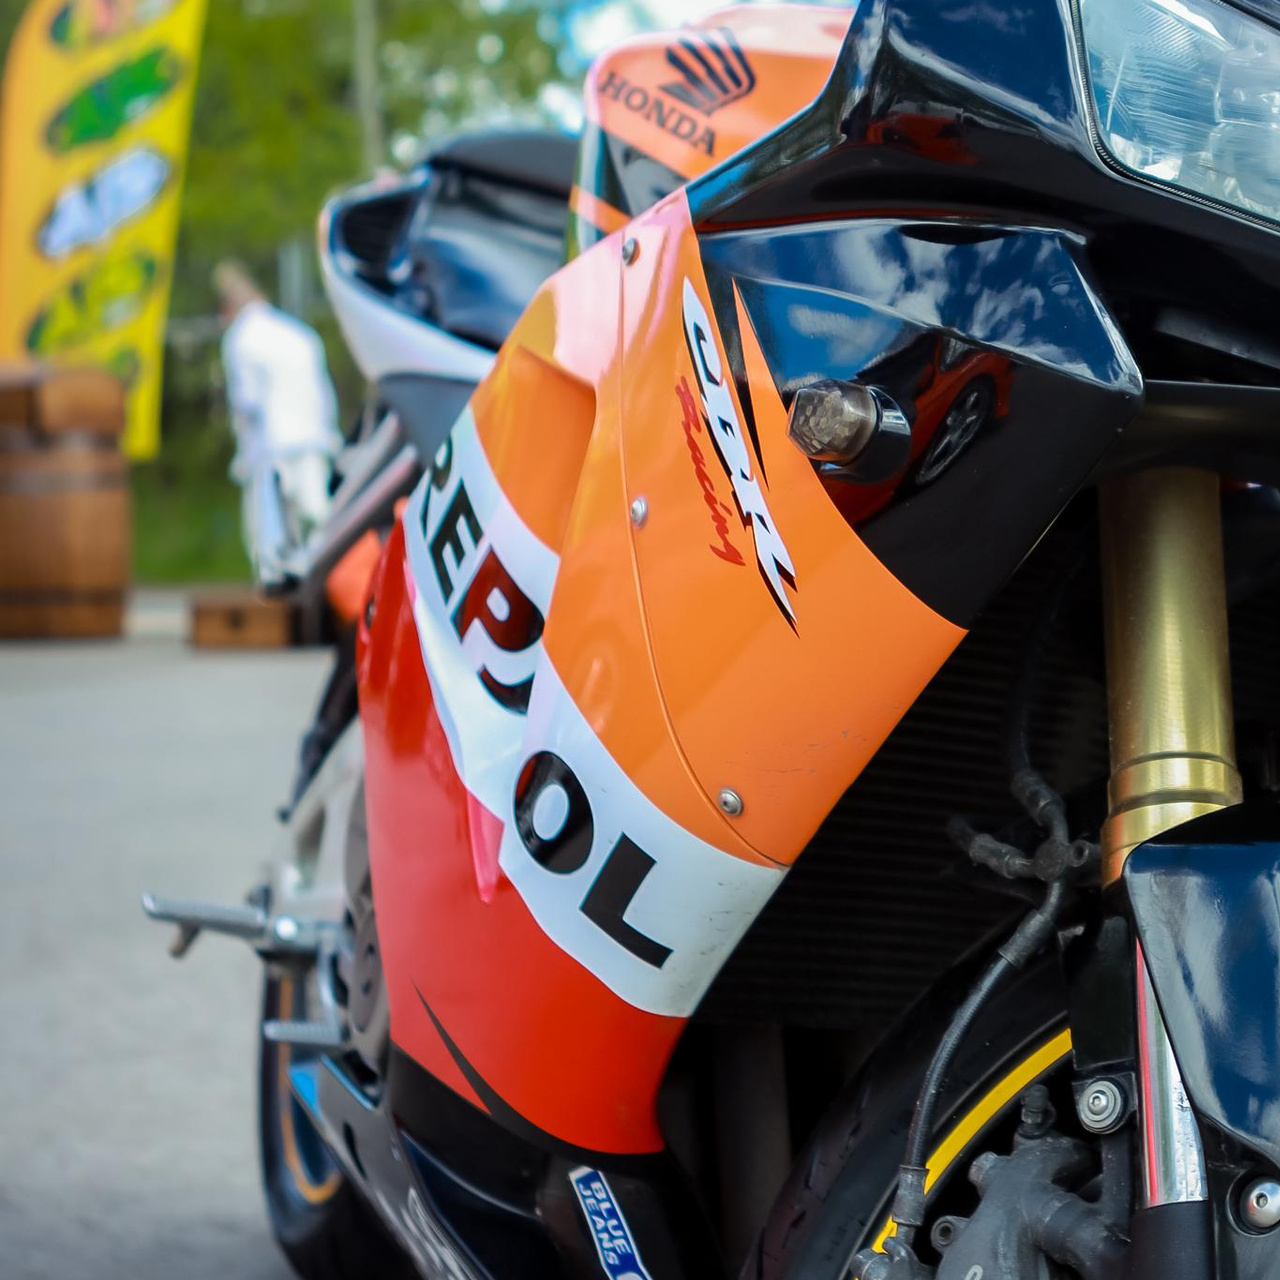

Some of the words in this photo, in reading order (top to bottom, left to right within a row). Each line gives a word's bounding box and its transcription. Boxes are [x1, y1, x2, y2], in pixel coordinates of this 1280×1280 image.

[599, 71, 717, 158] HONDA
[578, 1183, 619, 1266] JEANS
[590, 1181, 632, 1255] BLUE
